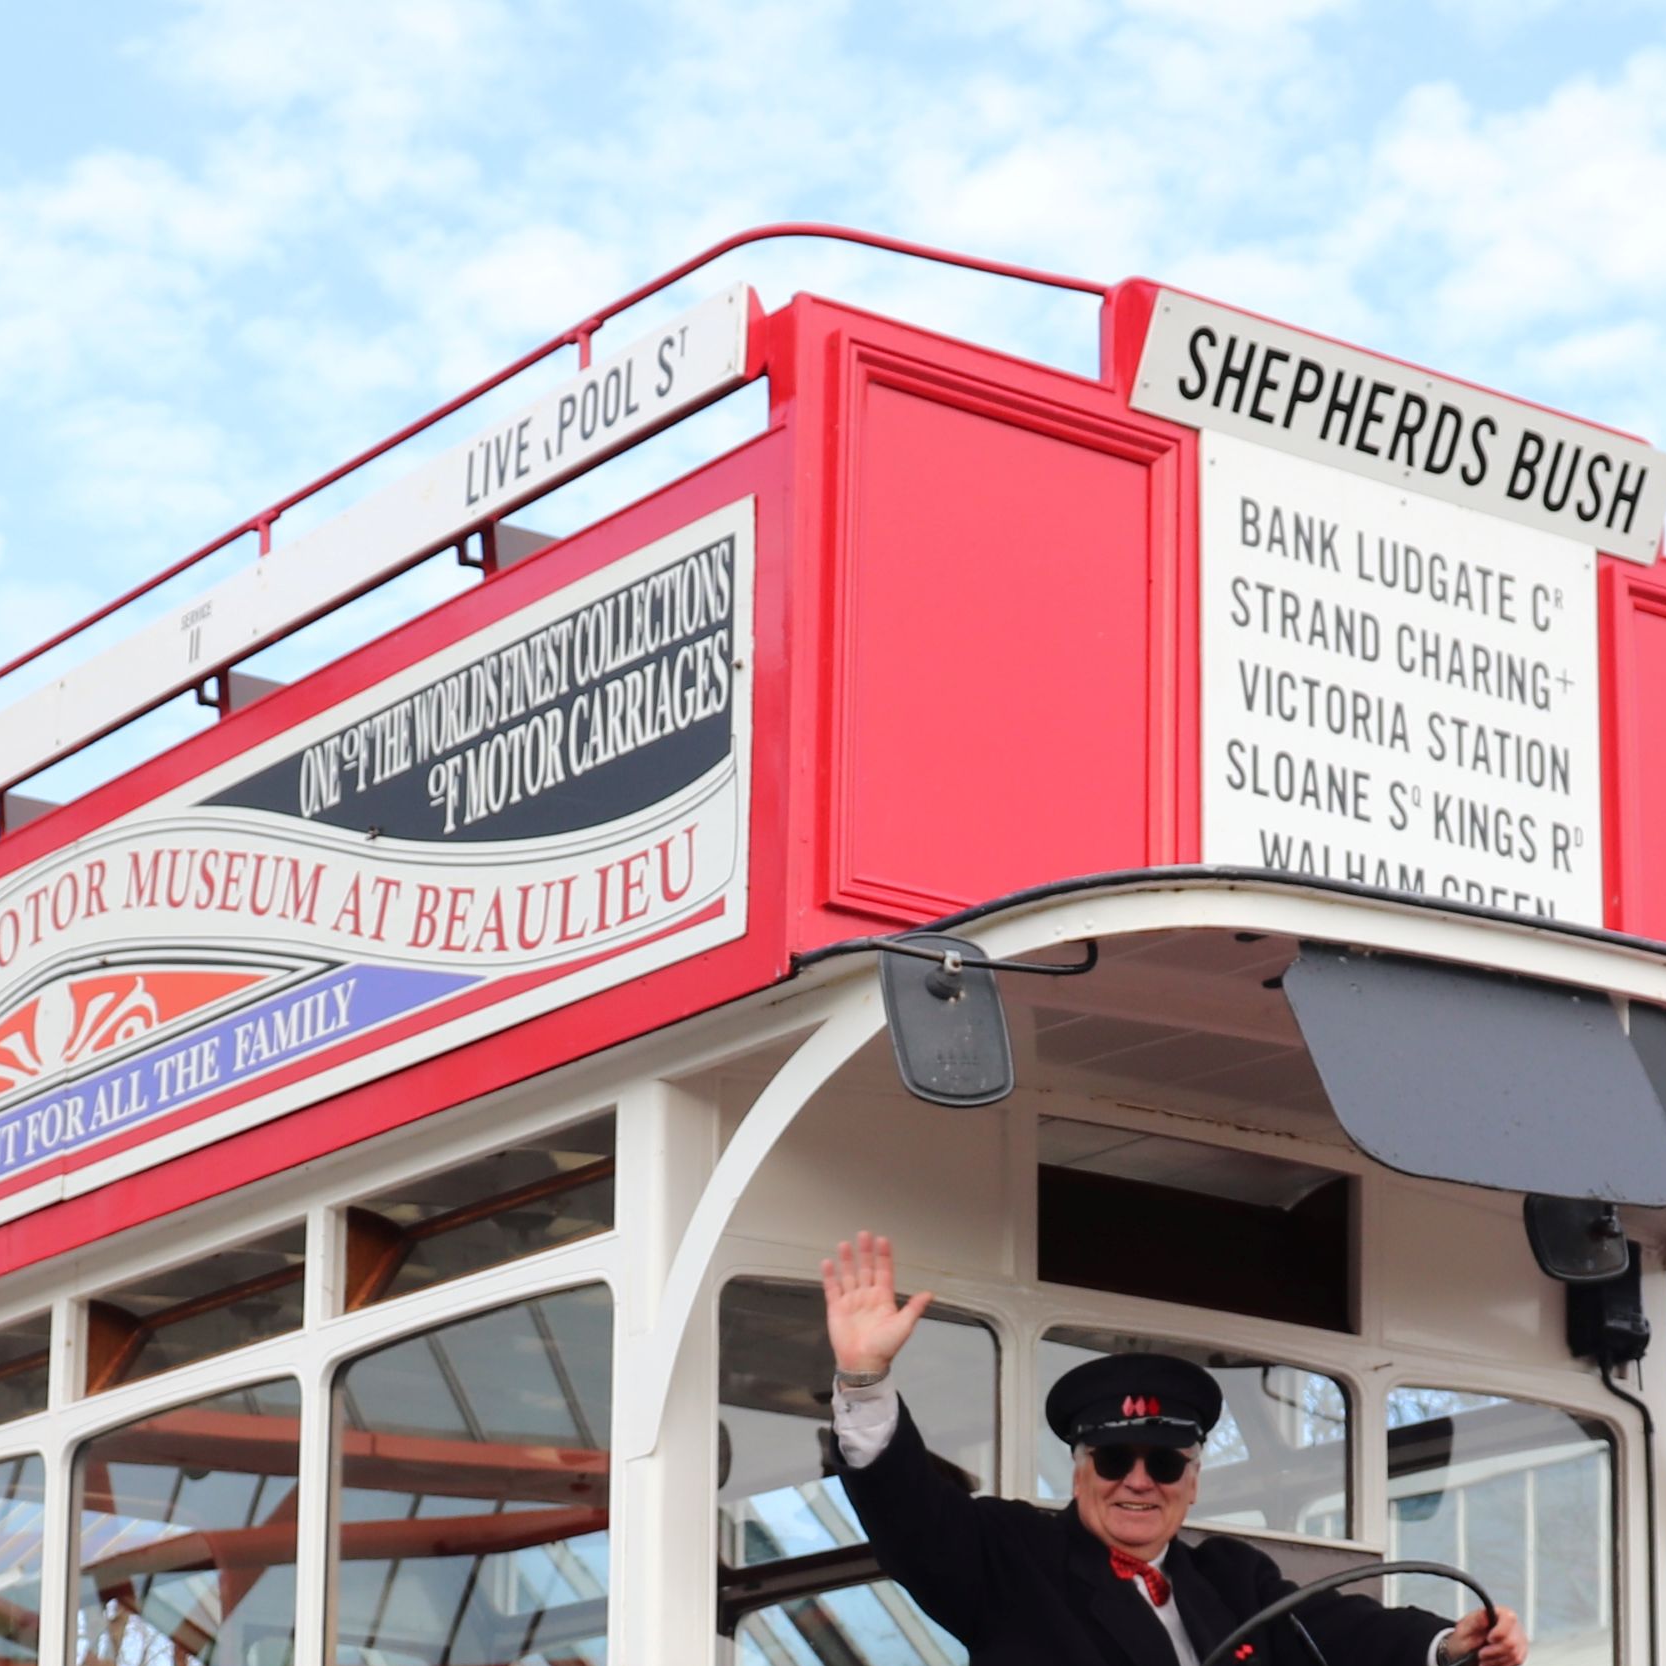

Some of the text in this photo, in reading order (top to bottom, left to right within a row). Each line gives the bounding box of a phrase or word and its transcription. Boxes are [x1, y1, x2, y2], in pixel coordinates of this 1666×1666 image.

[465, 326, 688, 507] LIVEPOOL ST
[1178, 325, 1648, 534] SHEPHERDS BUSH
[1231, 576, 1381, 662] STRAND
[1240, 496, 1564, 632] BANK LUDGATE CR
[300, 737, 342, 819] ONE
[343, 719, 375, 792] OF
[373, 700, 412, 785] THE
[499, 618, 574, 726] FINEST
[574, 540, 731, 687] COLLECTIONS
[428, 628, 730, 834] OF MOTOR CARRIAGES
[1238, 659, 1572, 796] VICTORIA STATION
[1226, 739, 1584, 873] SLOANE SQ KINGS RD
[124, 848, 328, 925] MUSEUM
[331, 870, 400, 940] AT
[407, 823, 699, 953] BEAULIEU
[24, 1090, 86, 1156] FOR
[89, 1069, 151, 1132] ALL
[154, 1036, 219, 1104] THE
[232, 977, 359, 1070] FAMILY
